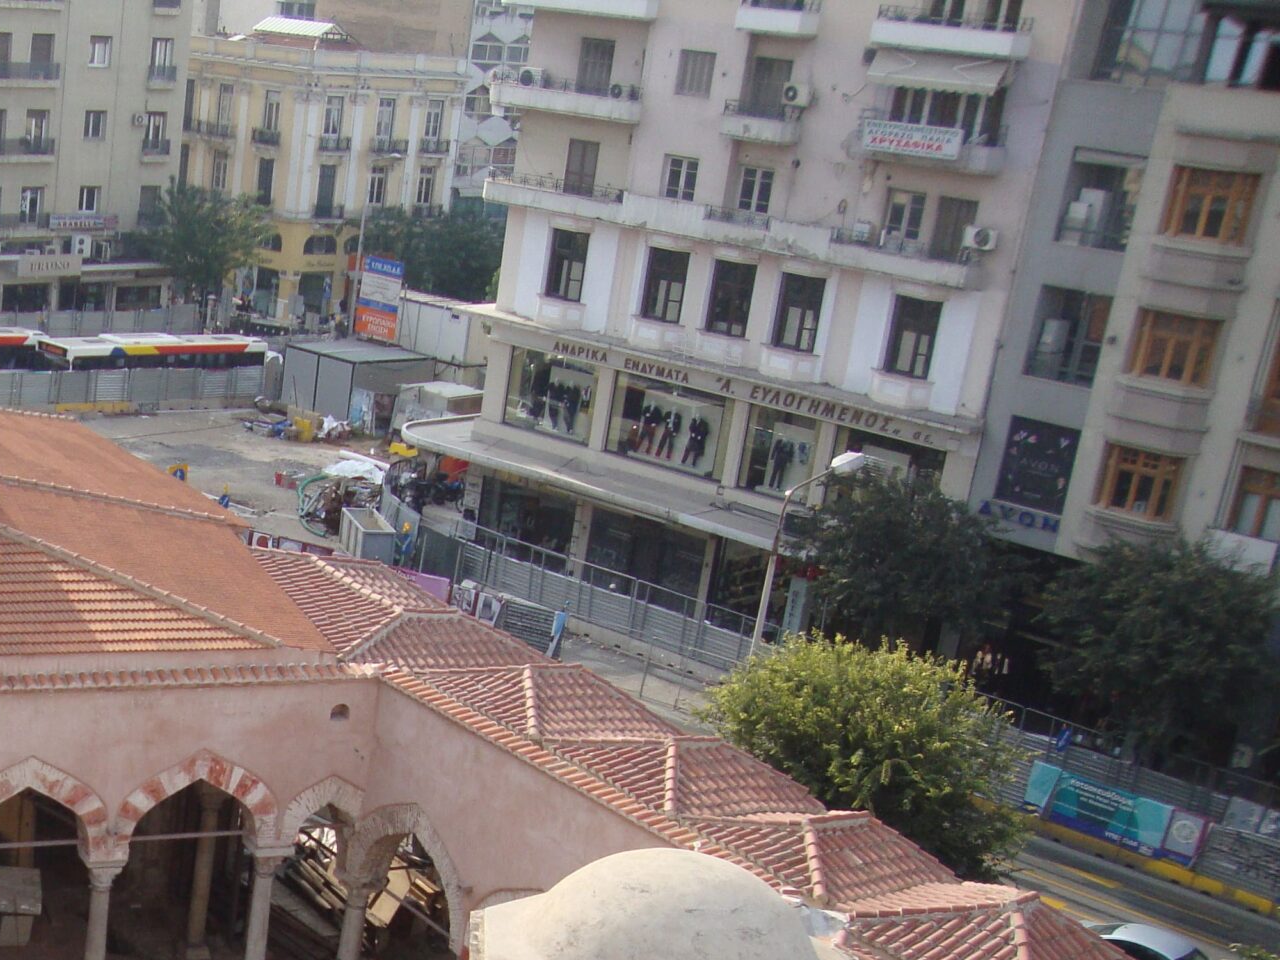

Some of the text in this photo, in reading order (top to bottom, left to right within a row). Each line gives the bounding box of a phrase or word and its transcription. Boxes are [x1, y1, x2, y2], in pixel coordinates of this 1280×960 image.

[870, 136, 945, 152] ΧΡΥΣΑΦΙΚΑ
[553, 341, 608, 363] ΑΝΔΡΙΚΑ
[624, 357, 689, 384] ΕΝΔΥΜΑΤΑ
[979, 501, 1060, 533] AVON
